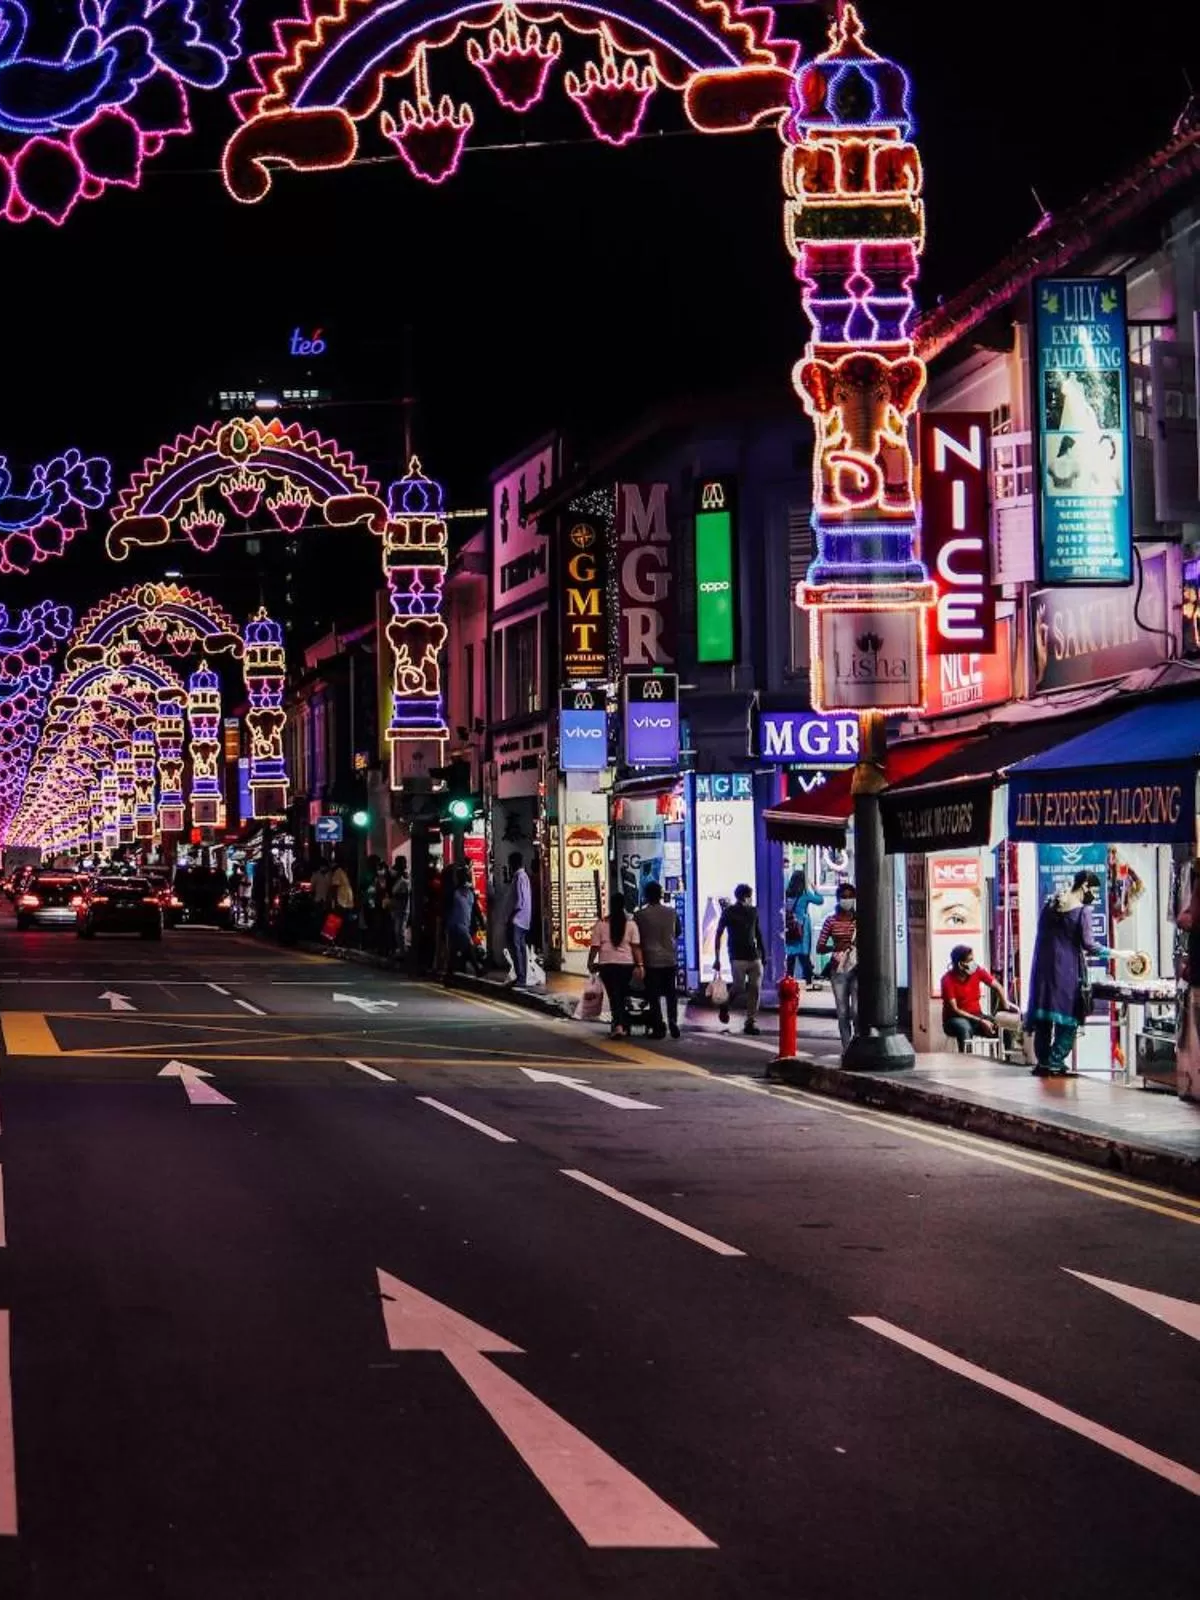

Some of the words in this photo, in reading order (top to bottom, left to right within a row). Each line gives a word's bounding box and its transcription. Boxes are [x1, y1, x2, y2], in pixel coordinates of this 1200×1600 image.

[1063, 285, 1098, 322] LILY
[1042, 346, 1121, 368] TAILOING
[934, 425, 984, 640] NICE
[620, 483, 675, 665] MGR
[699, 581, 730, 593] oppo
[566, 553, 603, 651] GMT
[834, 650, 908, 678] Lisha
[940, 653, 984, 692] NICE
[565, 727, 603, 738] vivo
[633, 716, 672, 728] vivo
[763, 719, 860, 756] MGR
[696, 776, 751, 793] MGR
[1016, 793, 1044, 826] LILY
[1044, 790, 1100, 826] EXPRESS
[1103, 785, 1182, 825] TAILORING
[934, 864, 978, 880] NICE
